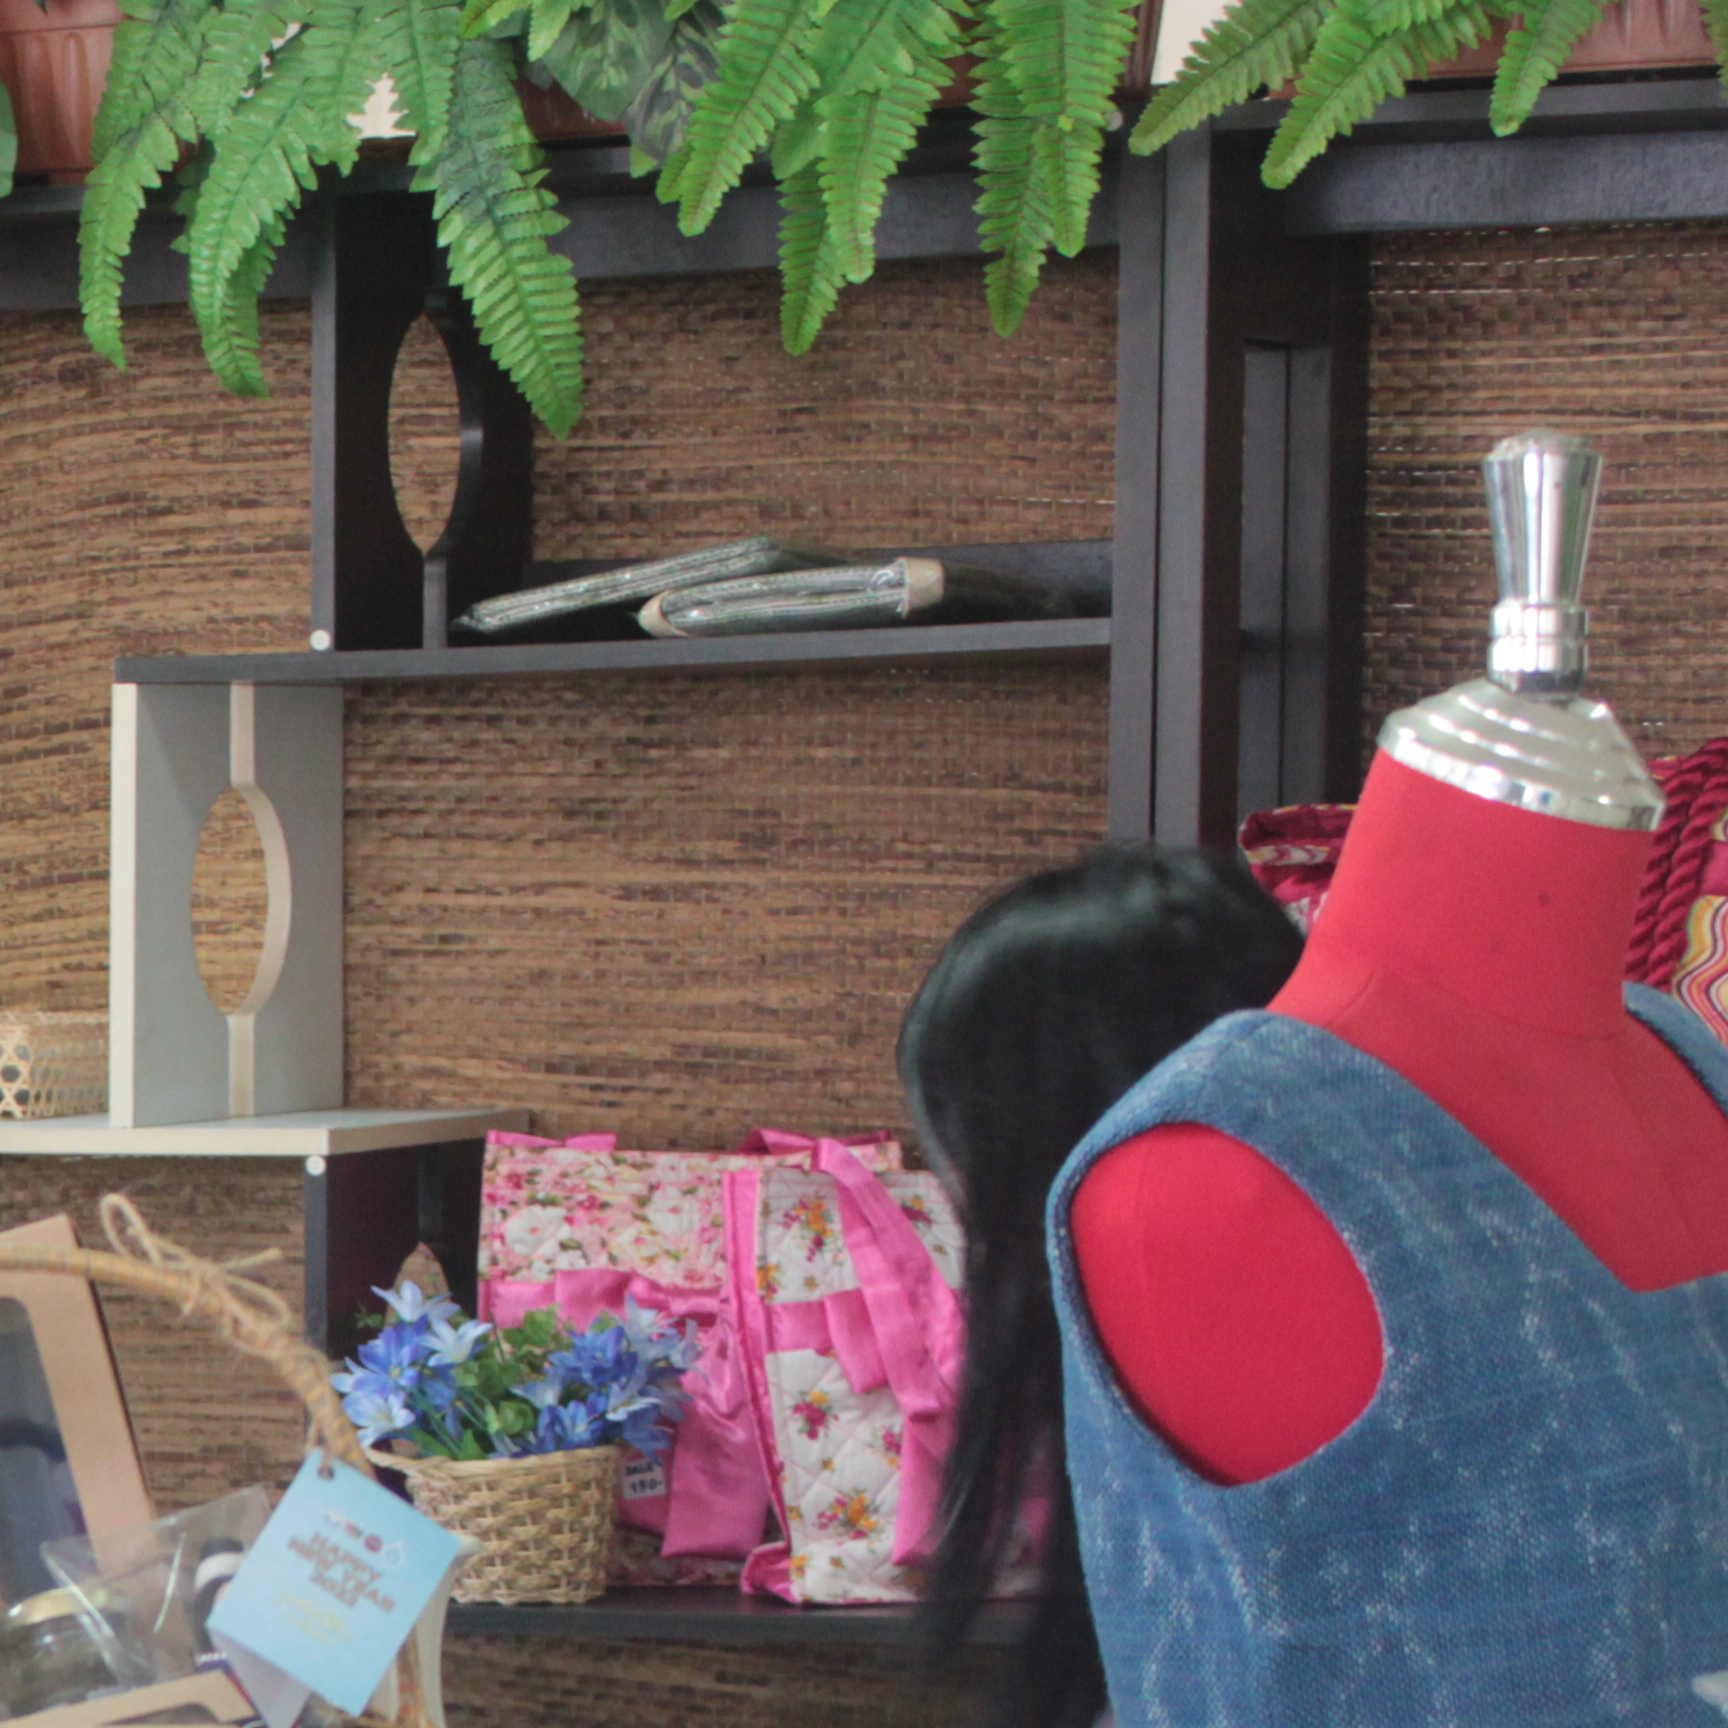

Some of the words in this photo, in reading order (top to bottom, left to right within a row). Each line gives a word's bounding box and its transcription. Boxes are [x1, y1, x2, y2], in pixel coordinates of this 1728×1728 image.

[287, 1536, 335, 1571] NEW
[343, 1569, 395, 1613] YEAR
[310, 1532, 382, 1582] HAPPY
